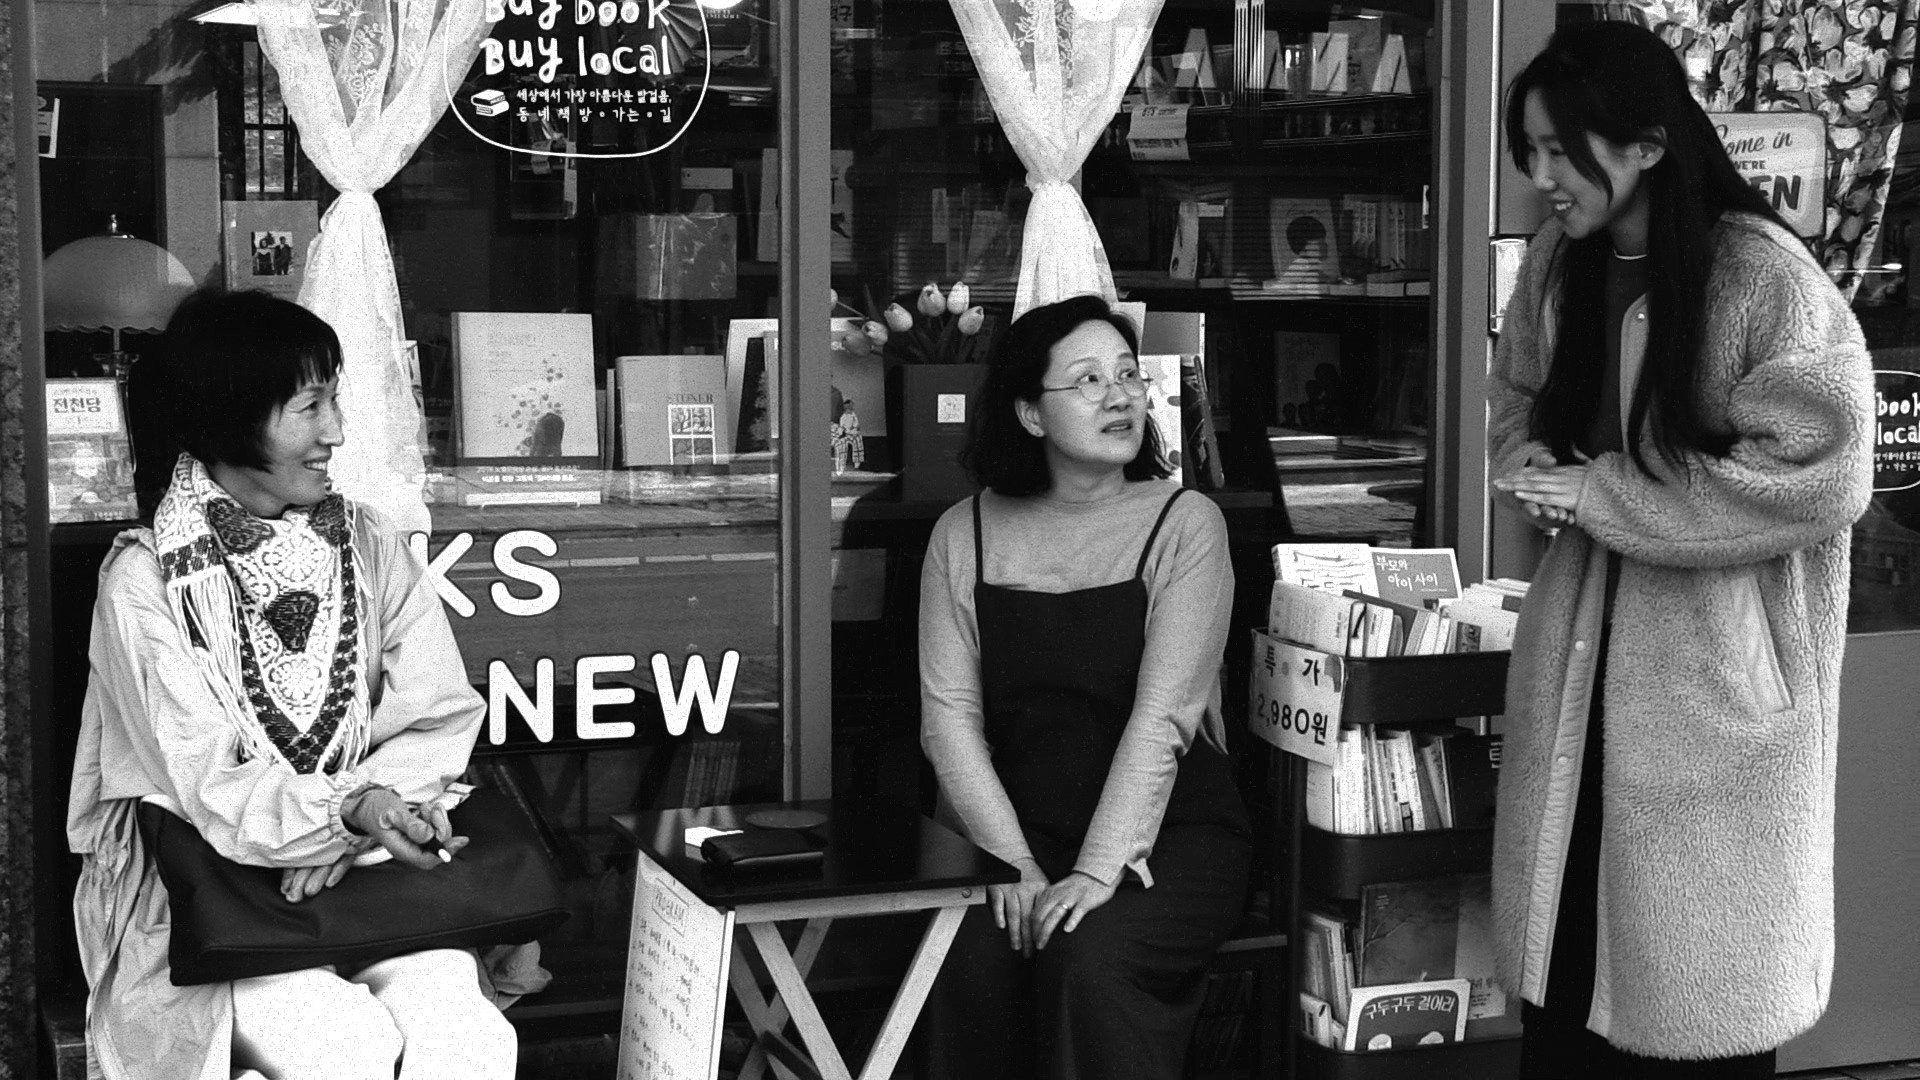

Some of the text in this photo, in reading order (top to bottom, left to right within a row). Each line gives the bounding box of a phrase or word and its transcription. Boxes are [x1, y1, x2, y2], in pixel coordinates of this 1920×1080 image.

[479, 35, 671, 83] Buy local
[516, 88, 561, 103] 세상에서
[564, 88, 587, 103] 가장
[589, 88, 634, 103] 아름다운
[612, 106, 640, 123] 가는
[660, 107, 672, 123] 길
[1773, 132, 1793, 149] in
[53, 397, 101, 414] 전천당
[1376, 555, 1408, 571] 부모와
[1388, 572, 1438, 592] 아이 사이
[489, 650, 740, 745] NEW
[1257, 693, 1328, 746] 2,980원
[1364, 995, 1416, 1020] 구두구두
